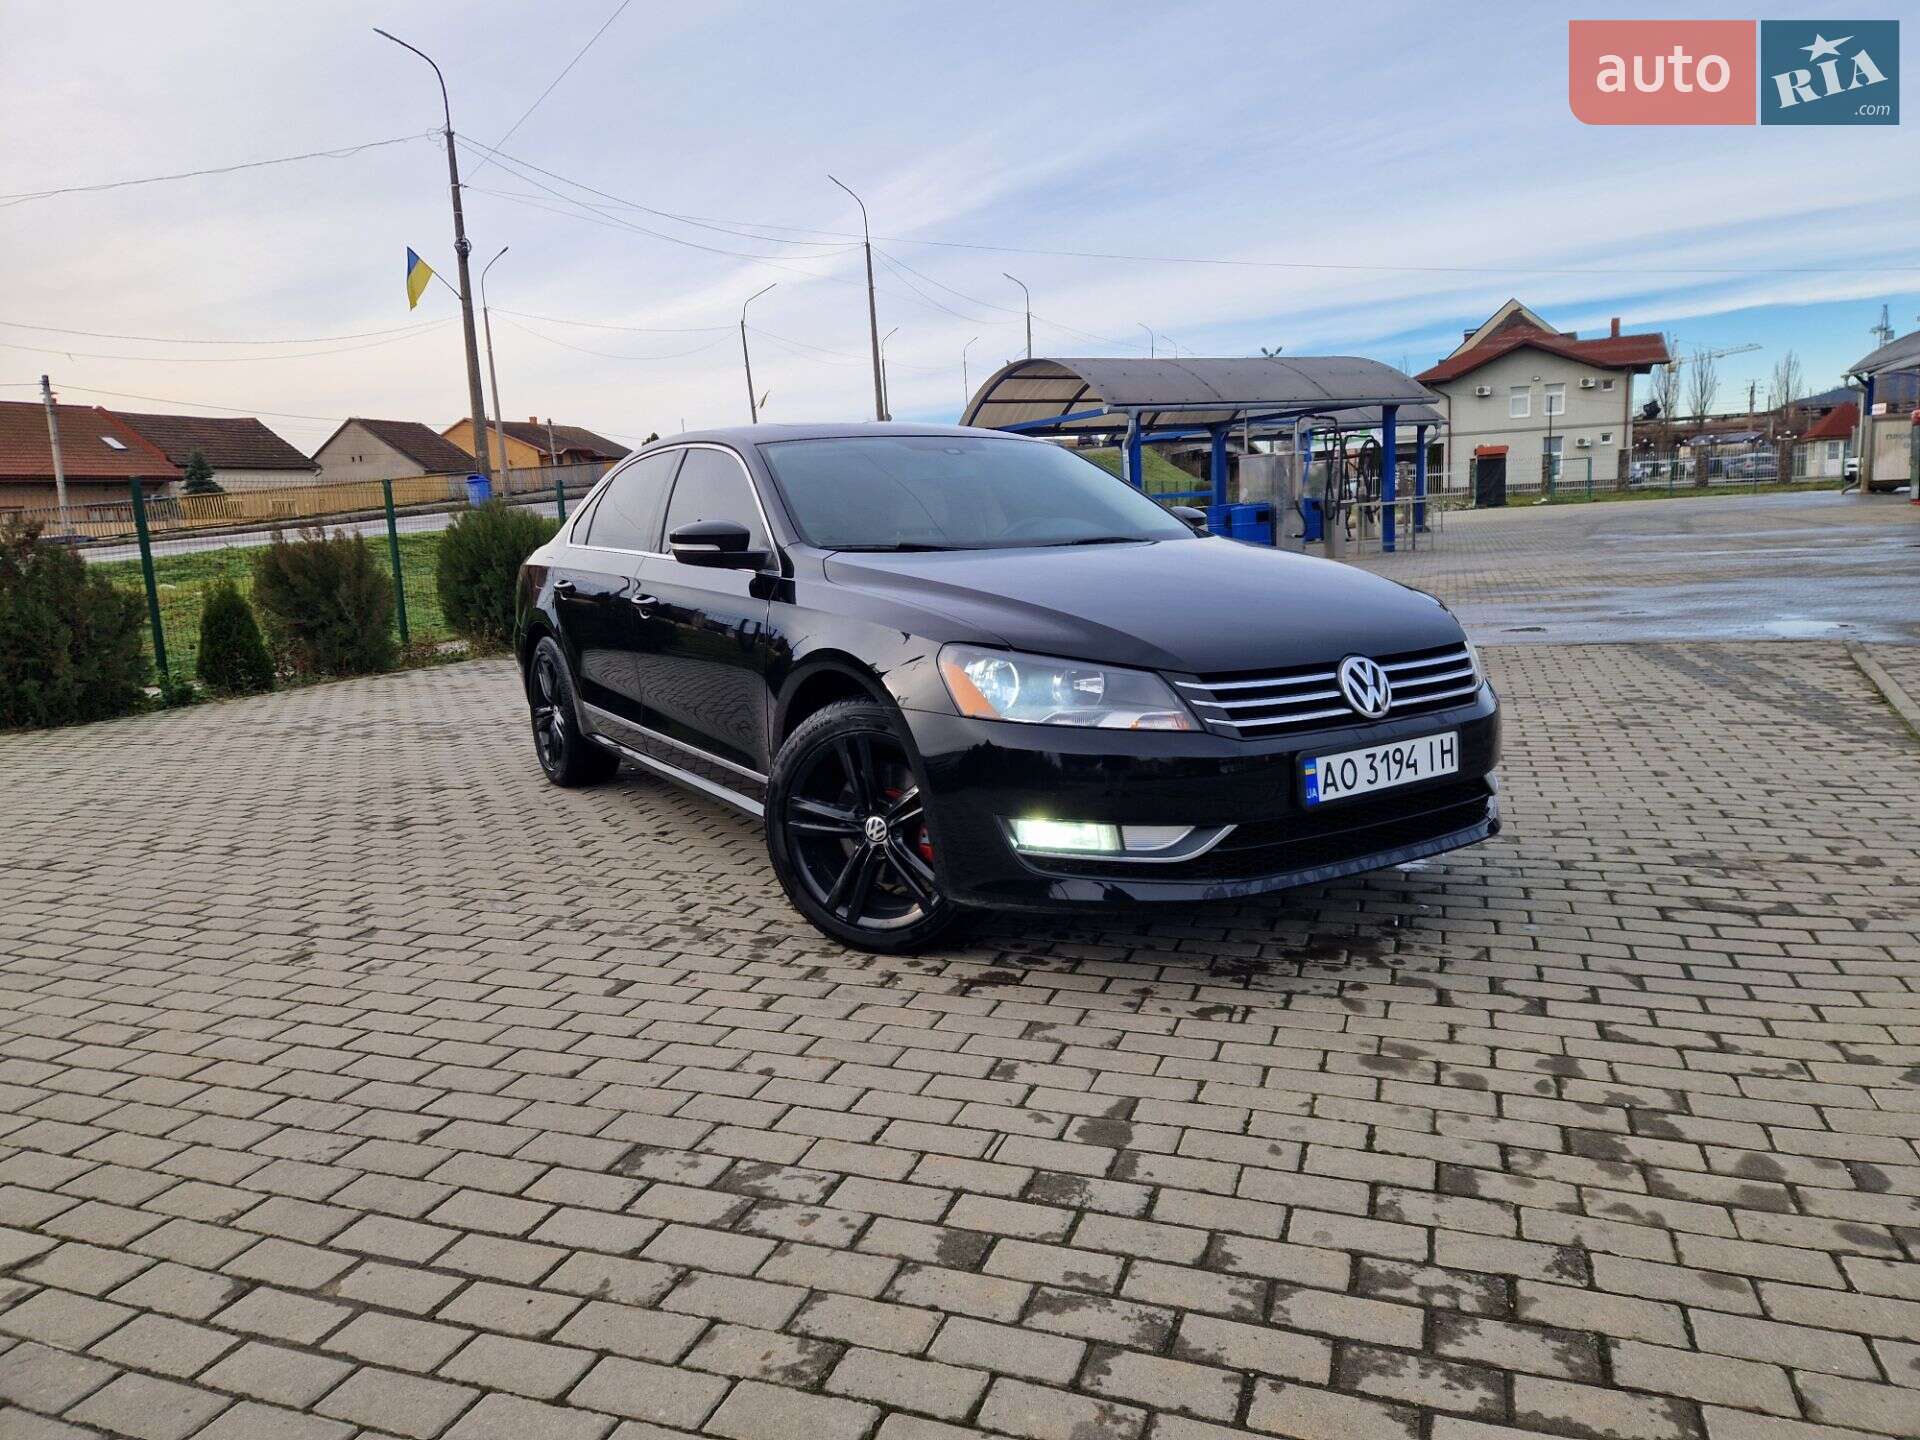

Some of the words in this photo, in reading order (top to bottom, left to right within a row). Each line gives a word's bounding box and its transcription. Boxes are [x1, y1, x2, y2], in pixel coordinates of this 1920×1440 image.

[1322, 757, 1358, 795] AO
[1365, 745, 1418, 785] 3194
[1429, 736, 1455, 772] IH
